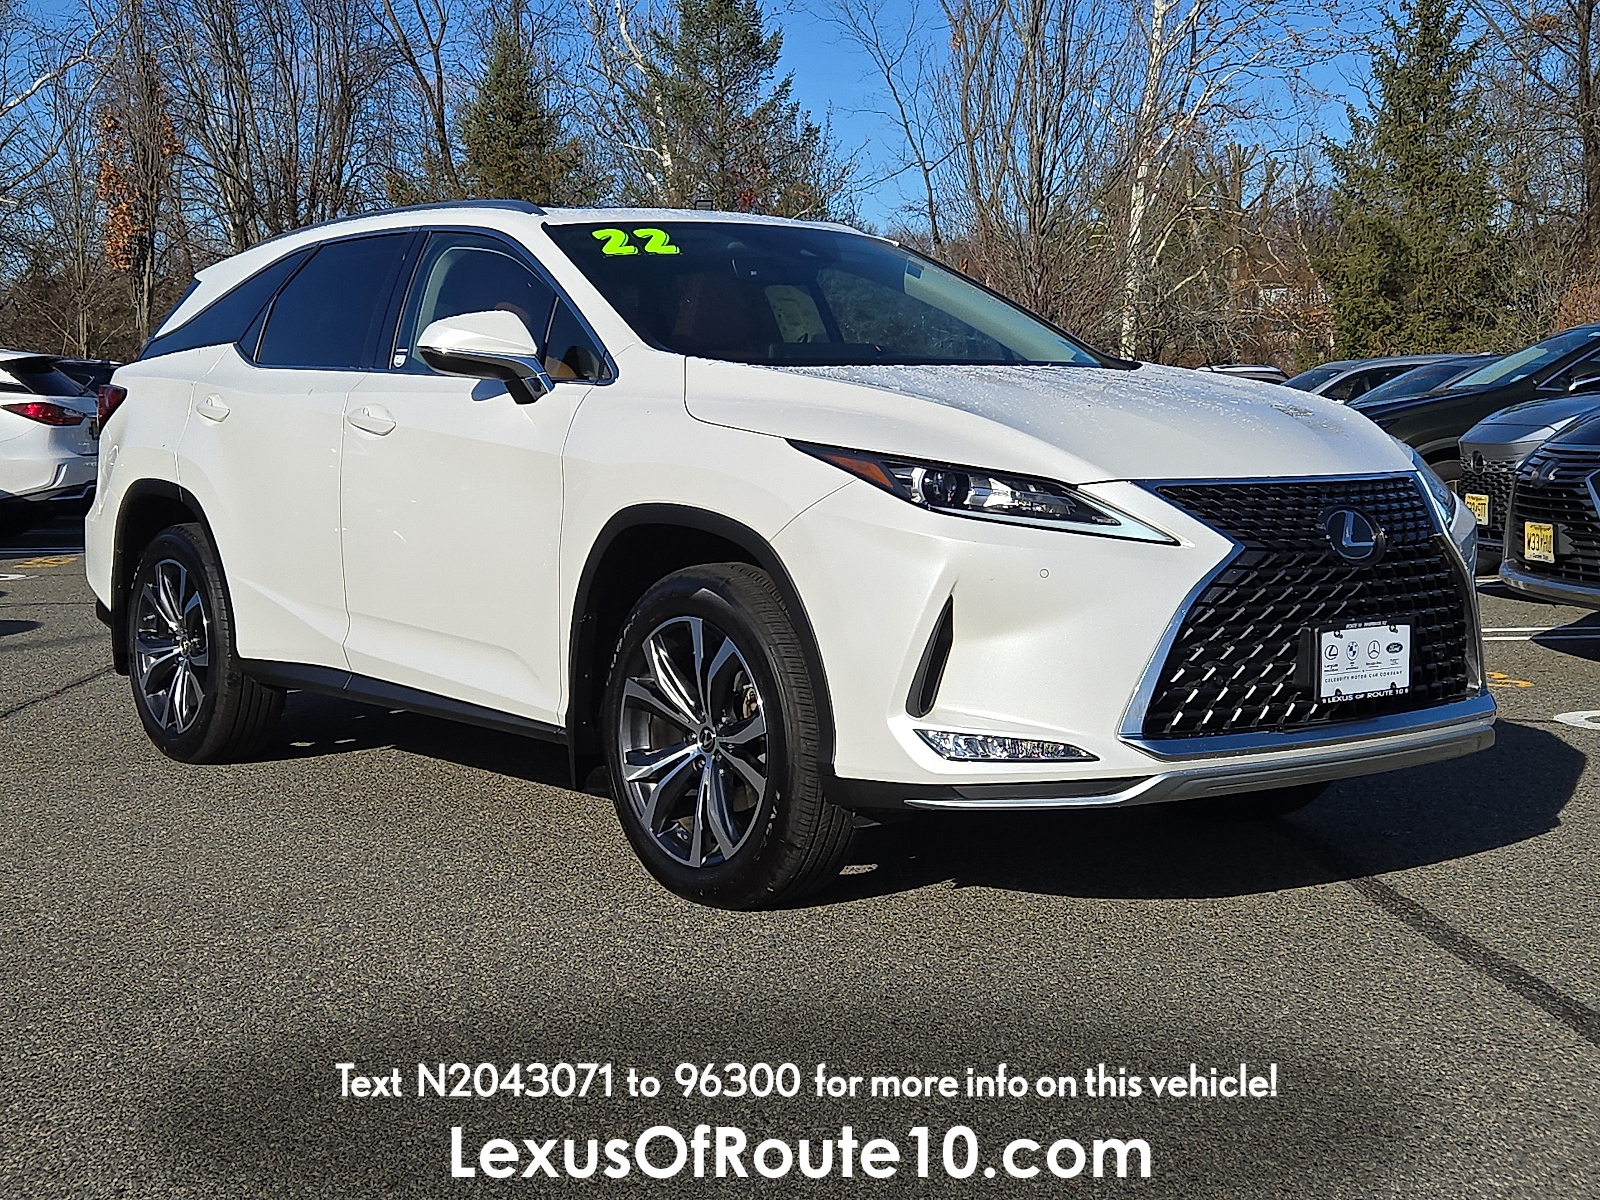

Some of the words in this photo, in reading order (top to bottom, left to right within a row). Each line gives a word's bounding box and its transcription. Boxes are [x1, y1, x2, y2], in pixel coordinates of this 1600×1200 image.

[591, 227, 682, 256] 22
[1328, 695, 1353, 703] LEXUS
[1367, 690, 1393, 698] ROUTE
